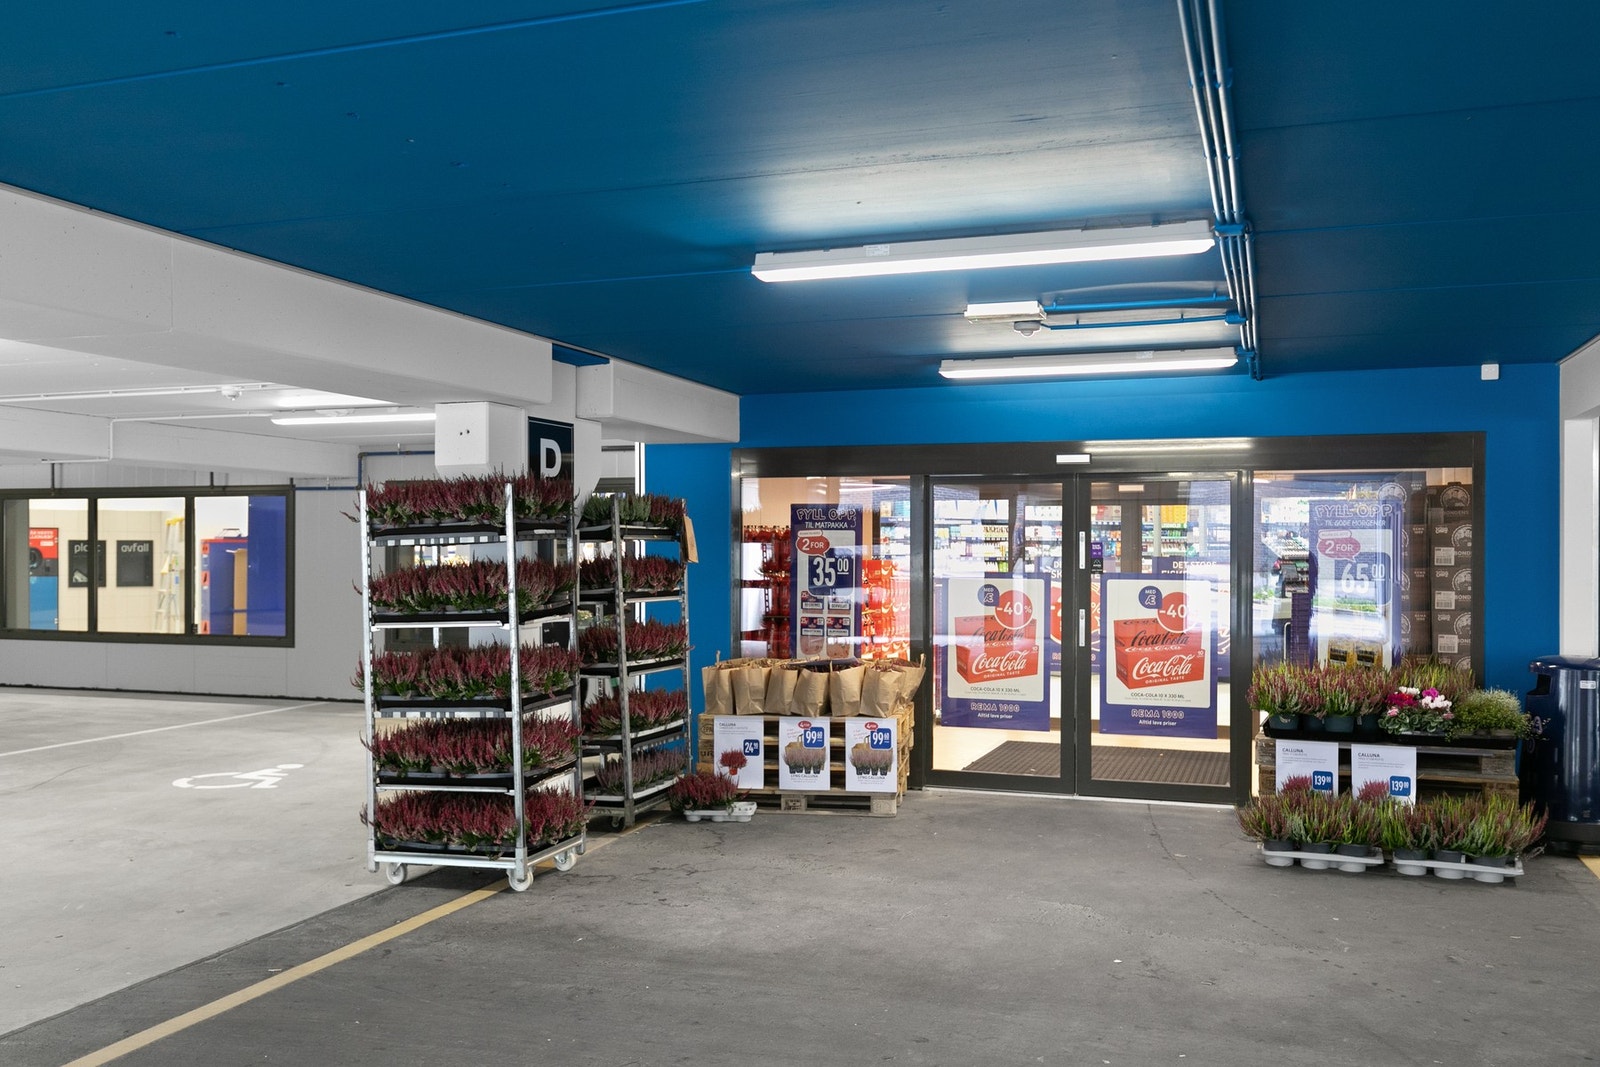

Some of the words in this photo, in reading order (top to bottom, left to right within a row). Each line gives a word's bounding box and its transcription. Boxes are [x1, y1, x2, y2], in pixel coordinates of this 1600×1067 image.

[540, 438, 562, 478] D
[796, 508, 826, 520] FYLL
[828, 508, 856, 520] OPP
[1315, 504, 1353, 518] FYLL
[1357, 504, 1392, 518] OPP
[120, 543, 150, 552] avfall
[802, 538, 810, 550] 2
[1325, 540, 1334, 554] 2
[813, 557, 836, 586] 35
[837, 558, 849, 572] 00
[1341, 562, 1369, 594] 65
[970, 702, 997, 711] REMA
[999, 704, 1020, 712] 1000
[1131, 709, 1160, 718] REMA
[1162, 710, 1184, 719] 1000
[806, 731, 817, 744] 99
[873, 732, 883, 744] 99
[745, 742, 754, 753] 24
[1314, 775, 1326, 785] 139
[1392, 781, 1403, 791] 139
